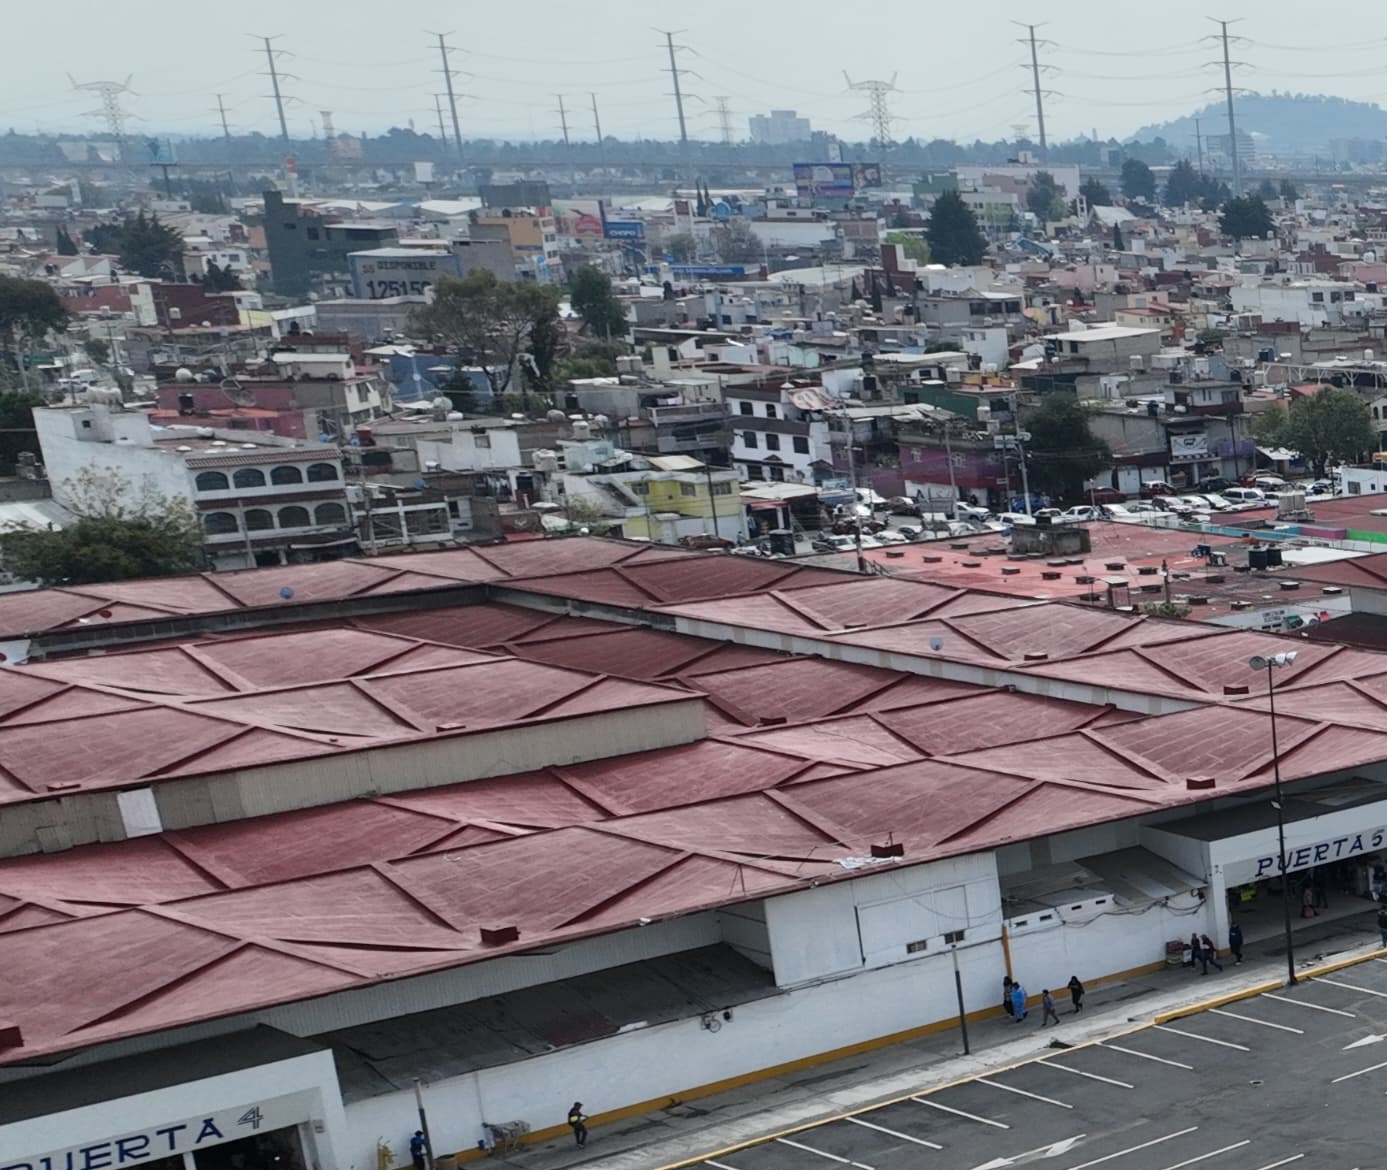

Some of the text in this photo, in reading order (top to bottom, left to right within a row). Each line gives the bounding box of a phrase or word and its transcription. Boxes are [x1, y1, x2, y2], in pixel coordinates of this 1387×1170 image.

[1255, 828, 1386, 877] PUERTA 5
[237, 1105, 265, 1130] 4
